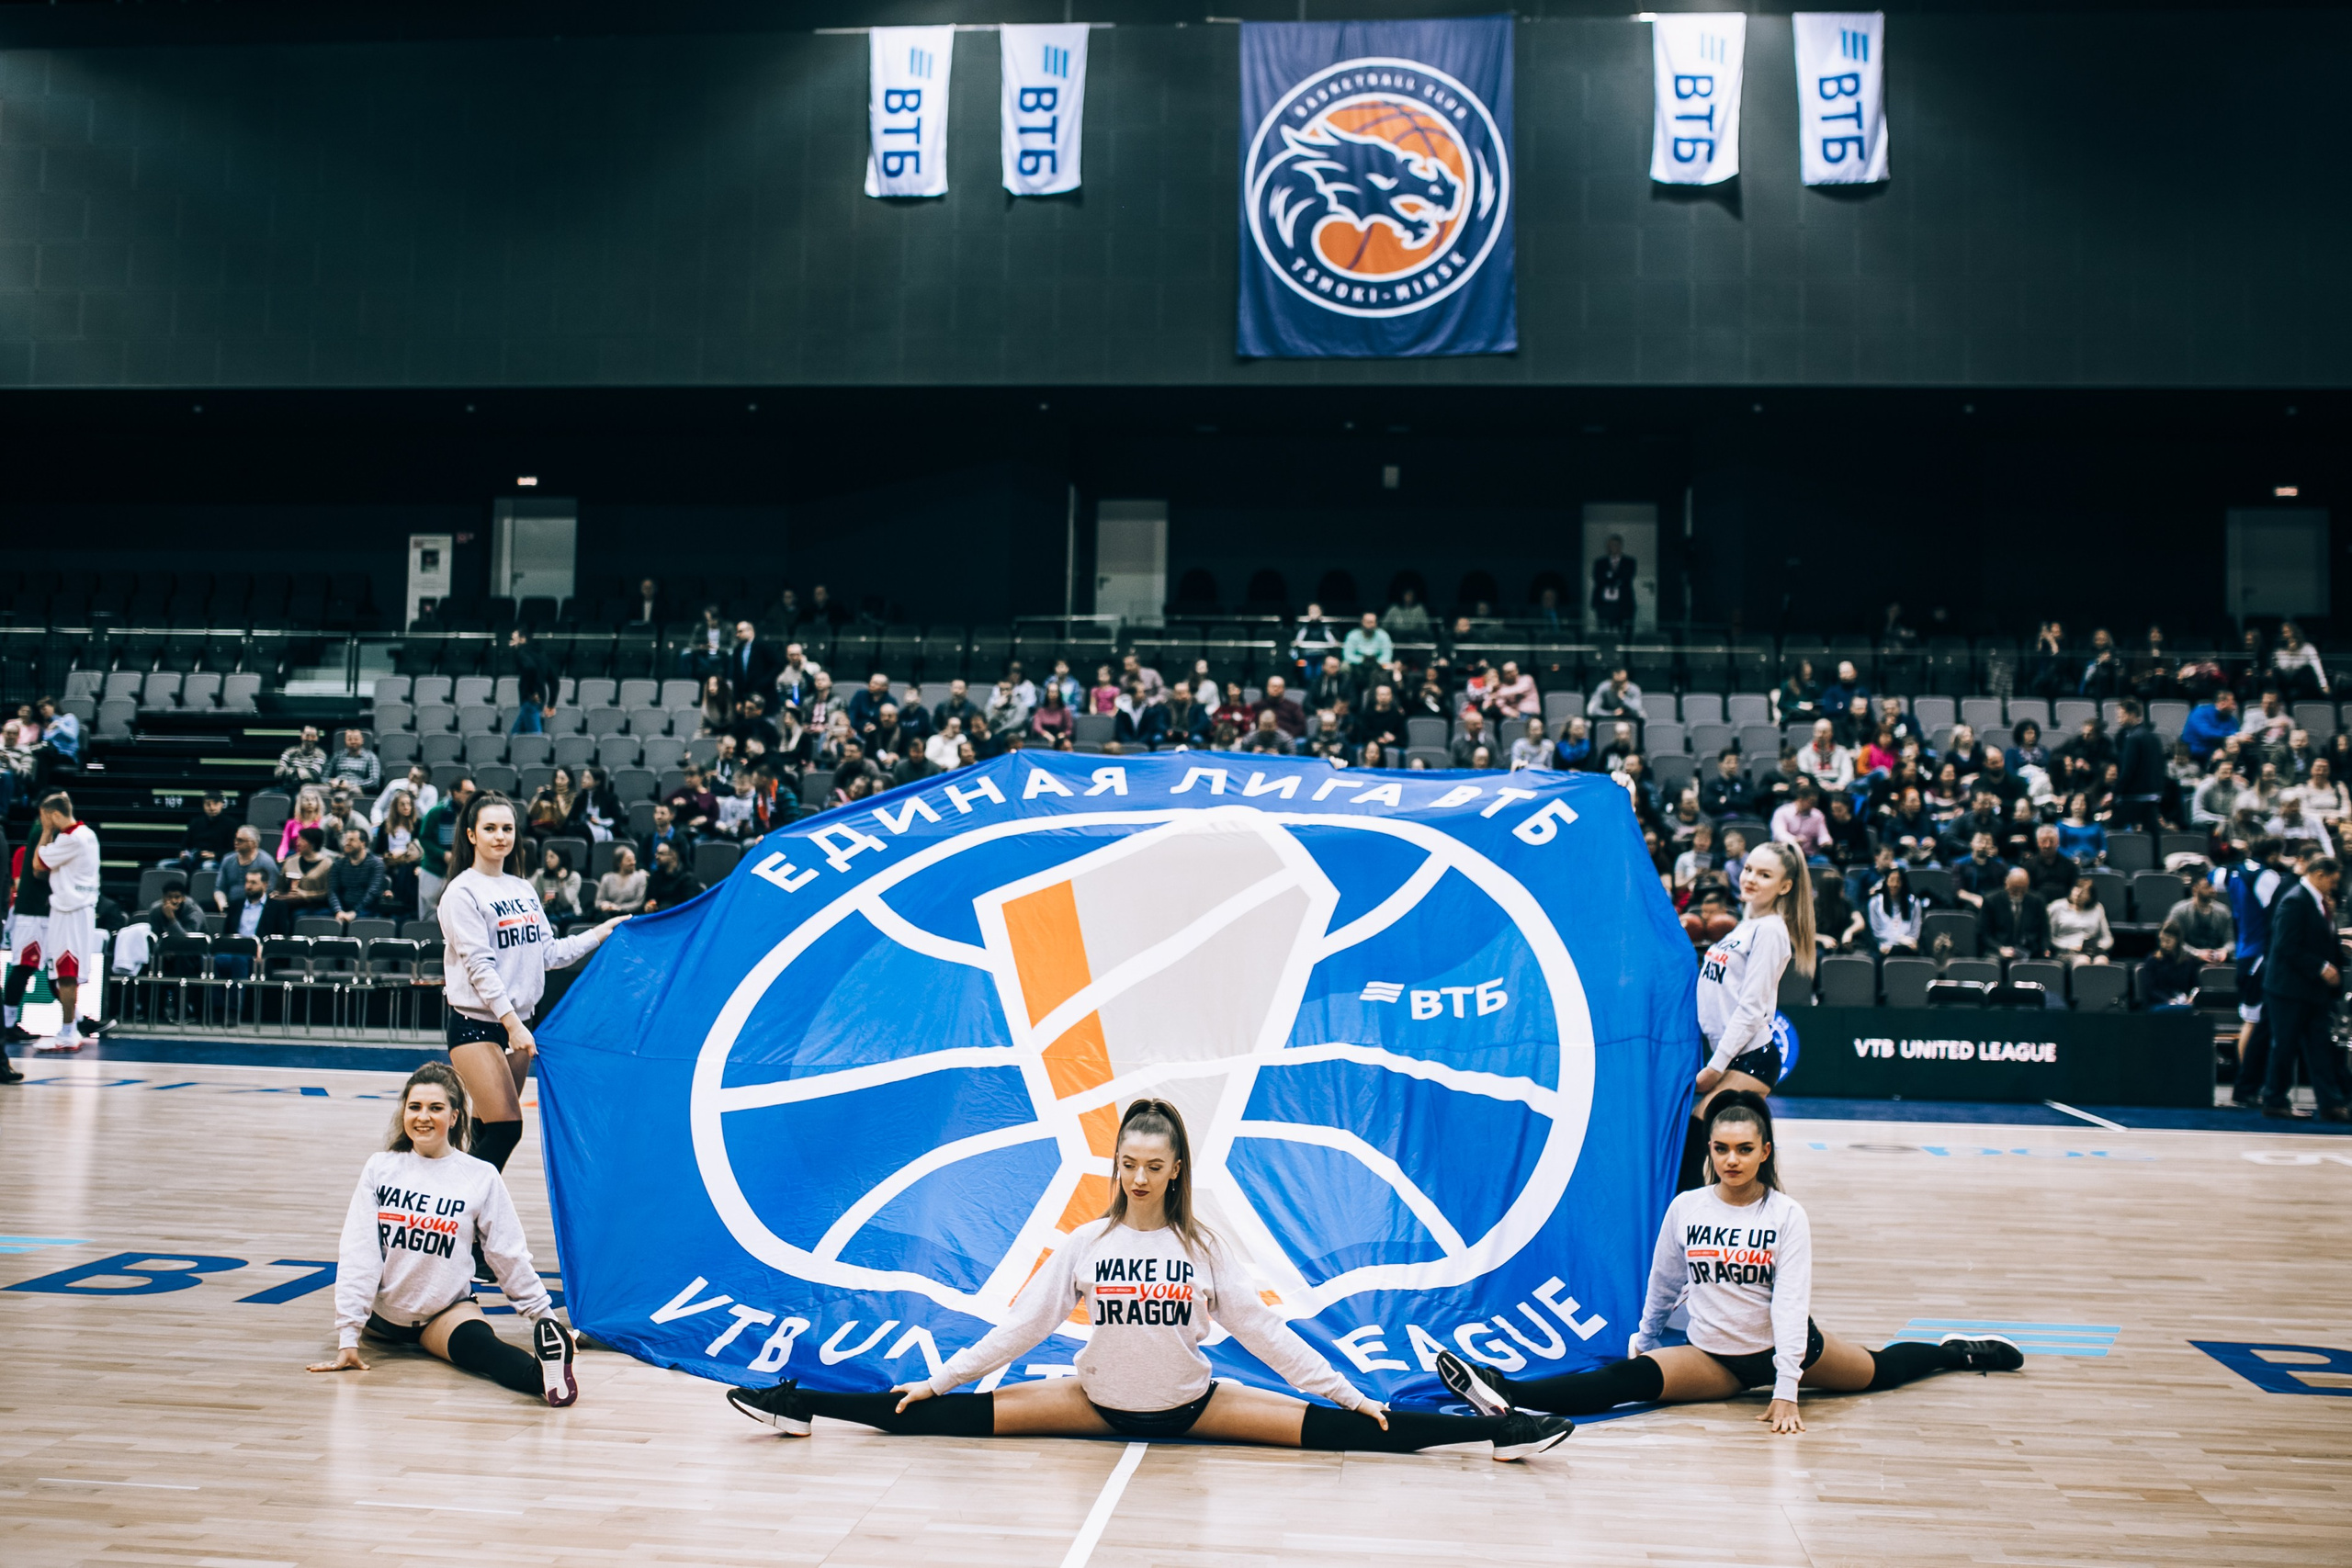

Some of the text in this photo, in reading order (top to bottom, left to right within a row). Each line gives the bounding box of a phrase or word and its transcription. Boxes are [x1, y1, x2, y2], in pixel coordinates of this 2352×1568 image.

[1294, 73, 1468, 120] BASKETBALL CLUB
[883, 89, 922, 178] ВТБ
[1018, 87, 1057, 176] ВТБ
[1673, 74, 1714, 163] ВТБ
[1819, 73, 1865, 164] ВТБ
[751, 766, 1578, 893] ЕДИНАЯ ЛИГА ВТБ
[490, 898, 528, 917] WAKE
[497, 924, 541, 949] DRAG
[1409, 976, 1509, 1021] ВТБ
[1854, 1038, 2057, 1063] VTB UNITED LEAGUE
[376, 1185, 466, 1217] WAKE UP
[378, 1222, 456, 1259] RAGON
[1686, 1224, 1777, 1249] WAKE UP
[1095, 1258, 1194, 1283] WAKE UP
[1688, 1261, 1775, 1285] DRAGON
[1095, 1299, 1193, 1326] DRAGON
[650, 1276, 811, 1373] VTB
[1297, 1276, 1608, 1393] EAGUE
